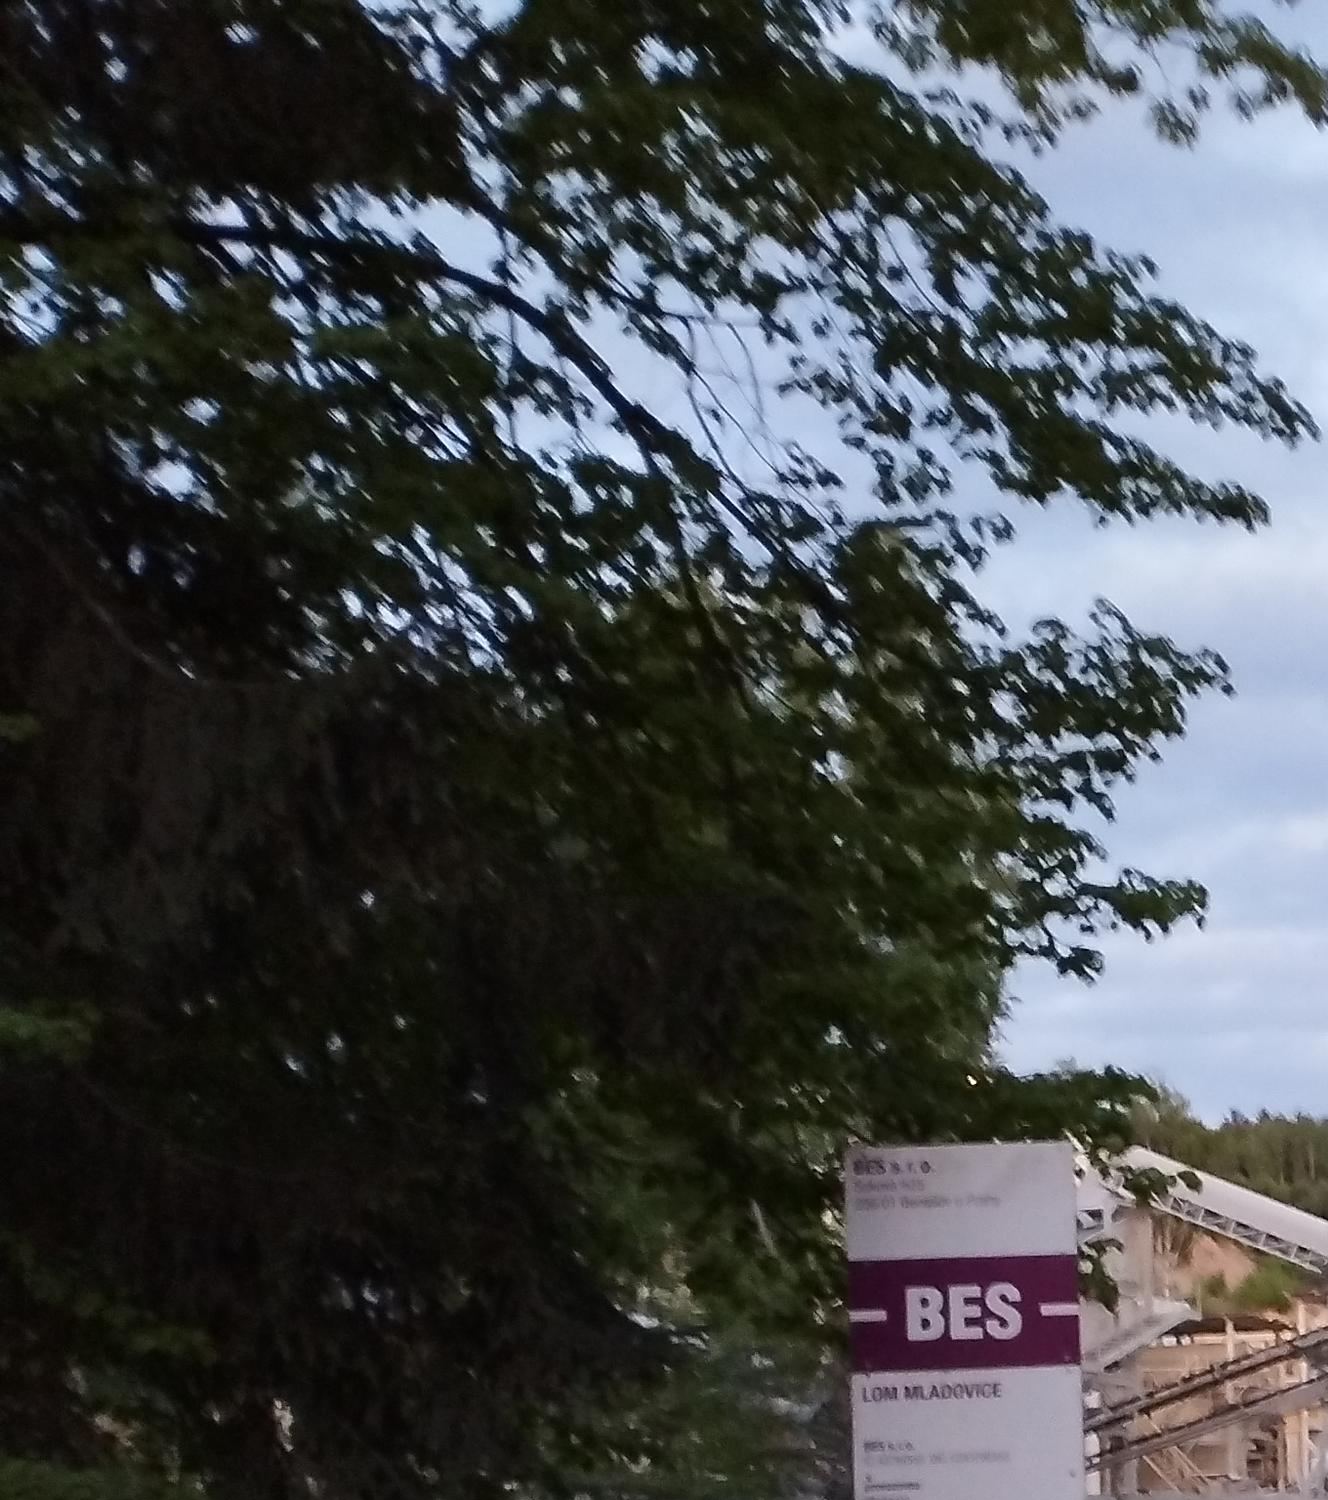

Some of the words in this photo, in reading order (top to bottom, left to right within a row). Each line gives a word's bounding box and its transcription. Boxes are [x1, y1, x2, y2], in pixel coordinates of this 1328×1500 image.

[905, 1281, 1023, 1341] BES
[862, 1385, 898, 1402] LOM
[904, 1383, 1002, 1400] MLADOVICE
